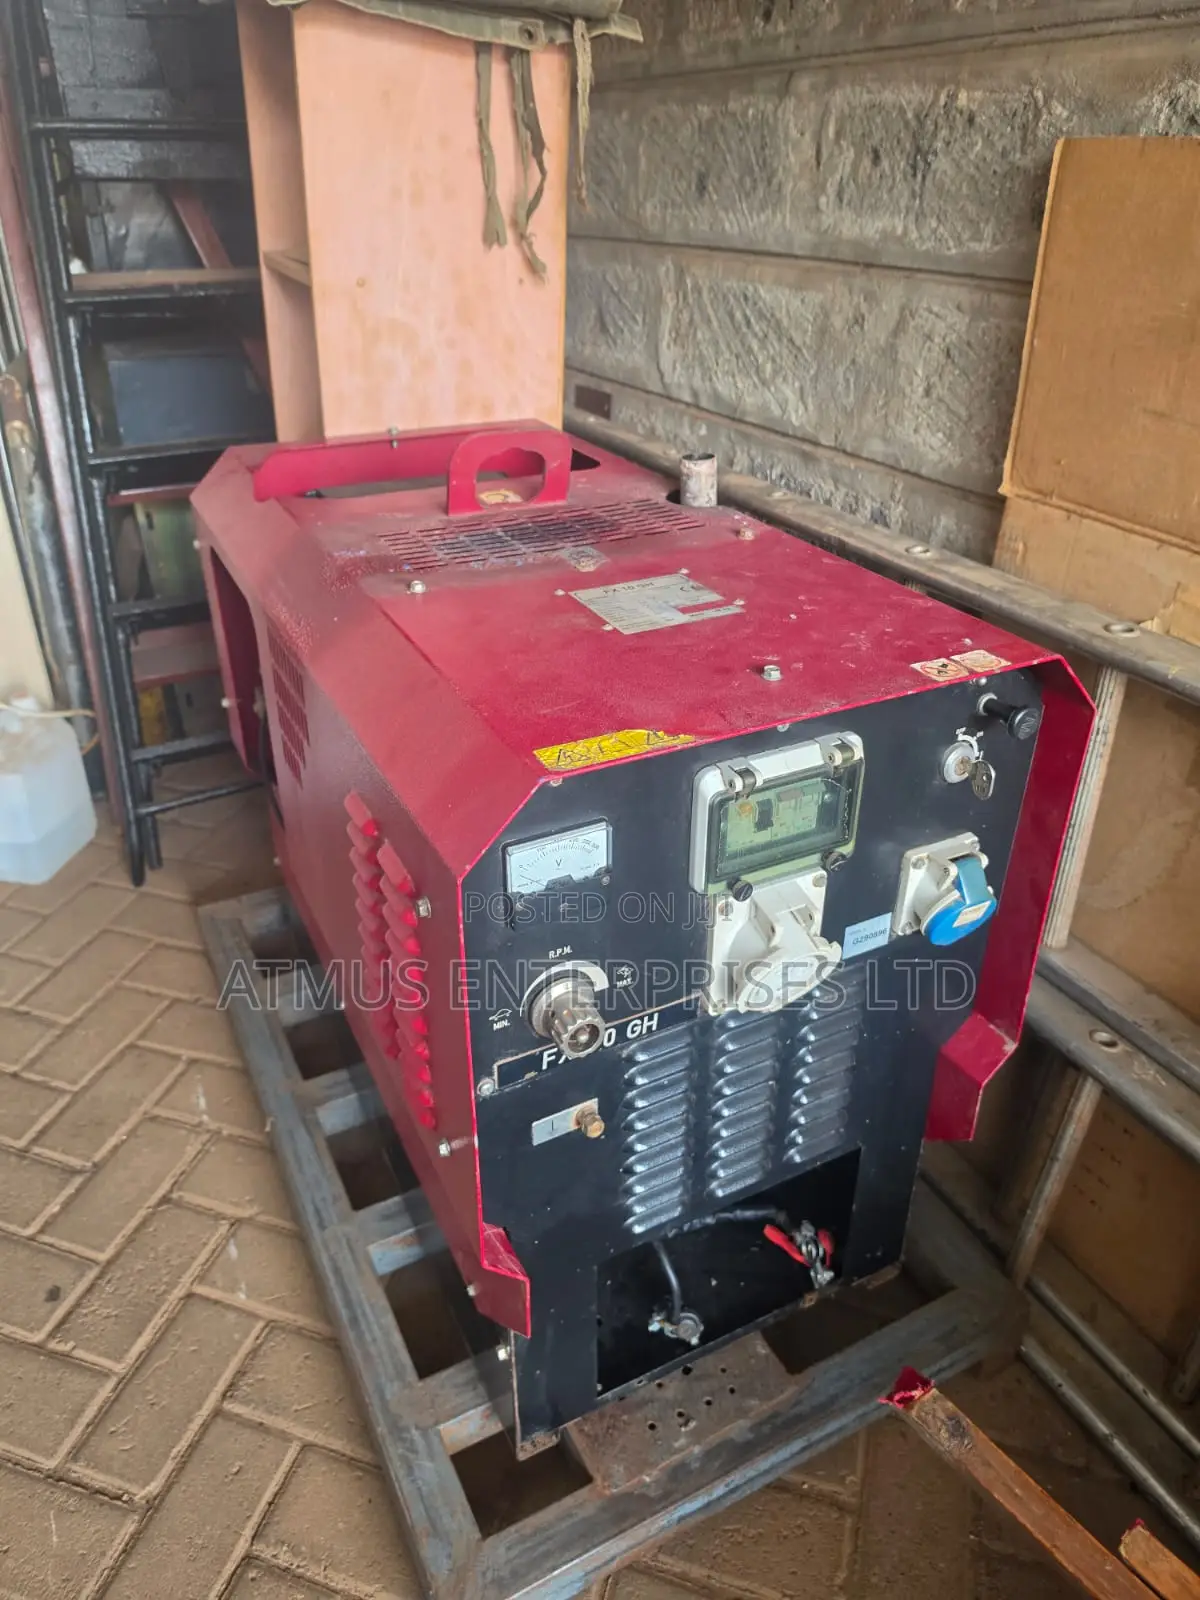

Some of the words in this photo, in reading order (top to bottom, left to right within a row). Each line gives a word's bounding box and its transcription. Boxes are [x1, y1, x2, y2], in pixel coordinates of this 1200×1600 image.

[555, 858, 562, 867] V
[549, 945, 573, 959] R.P.M.
[493, 1019, 511, 1031] MIN.
[626, 1012, 659, 1039] GH
